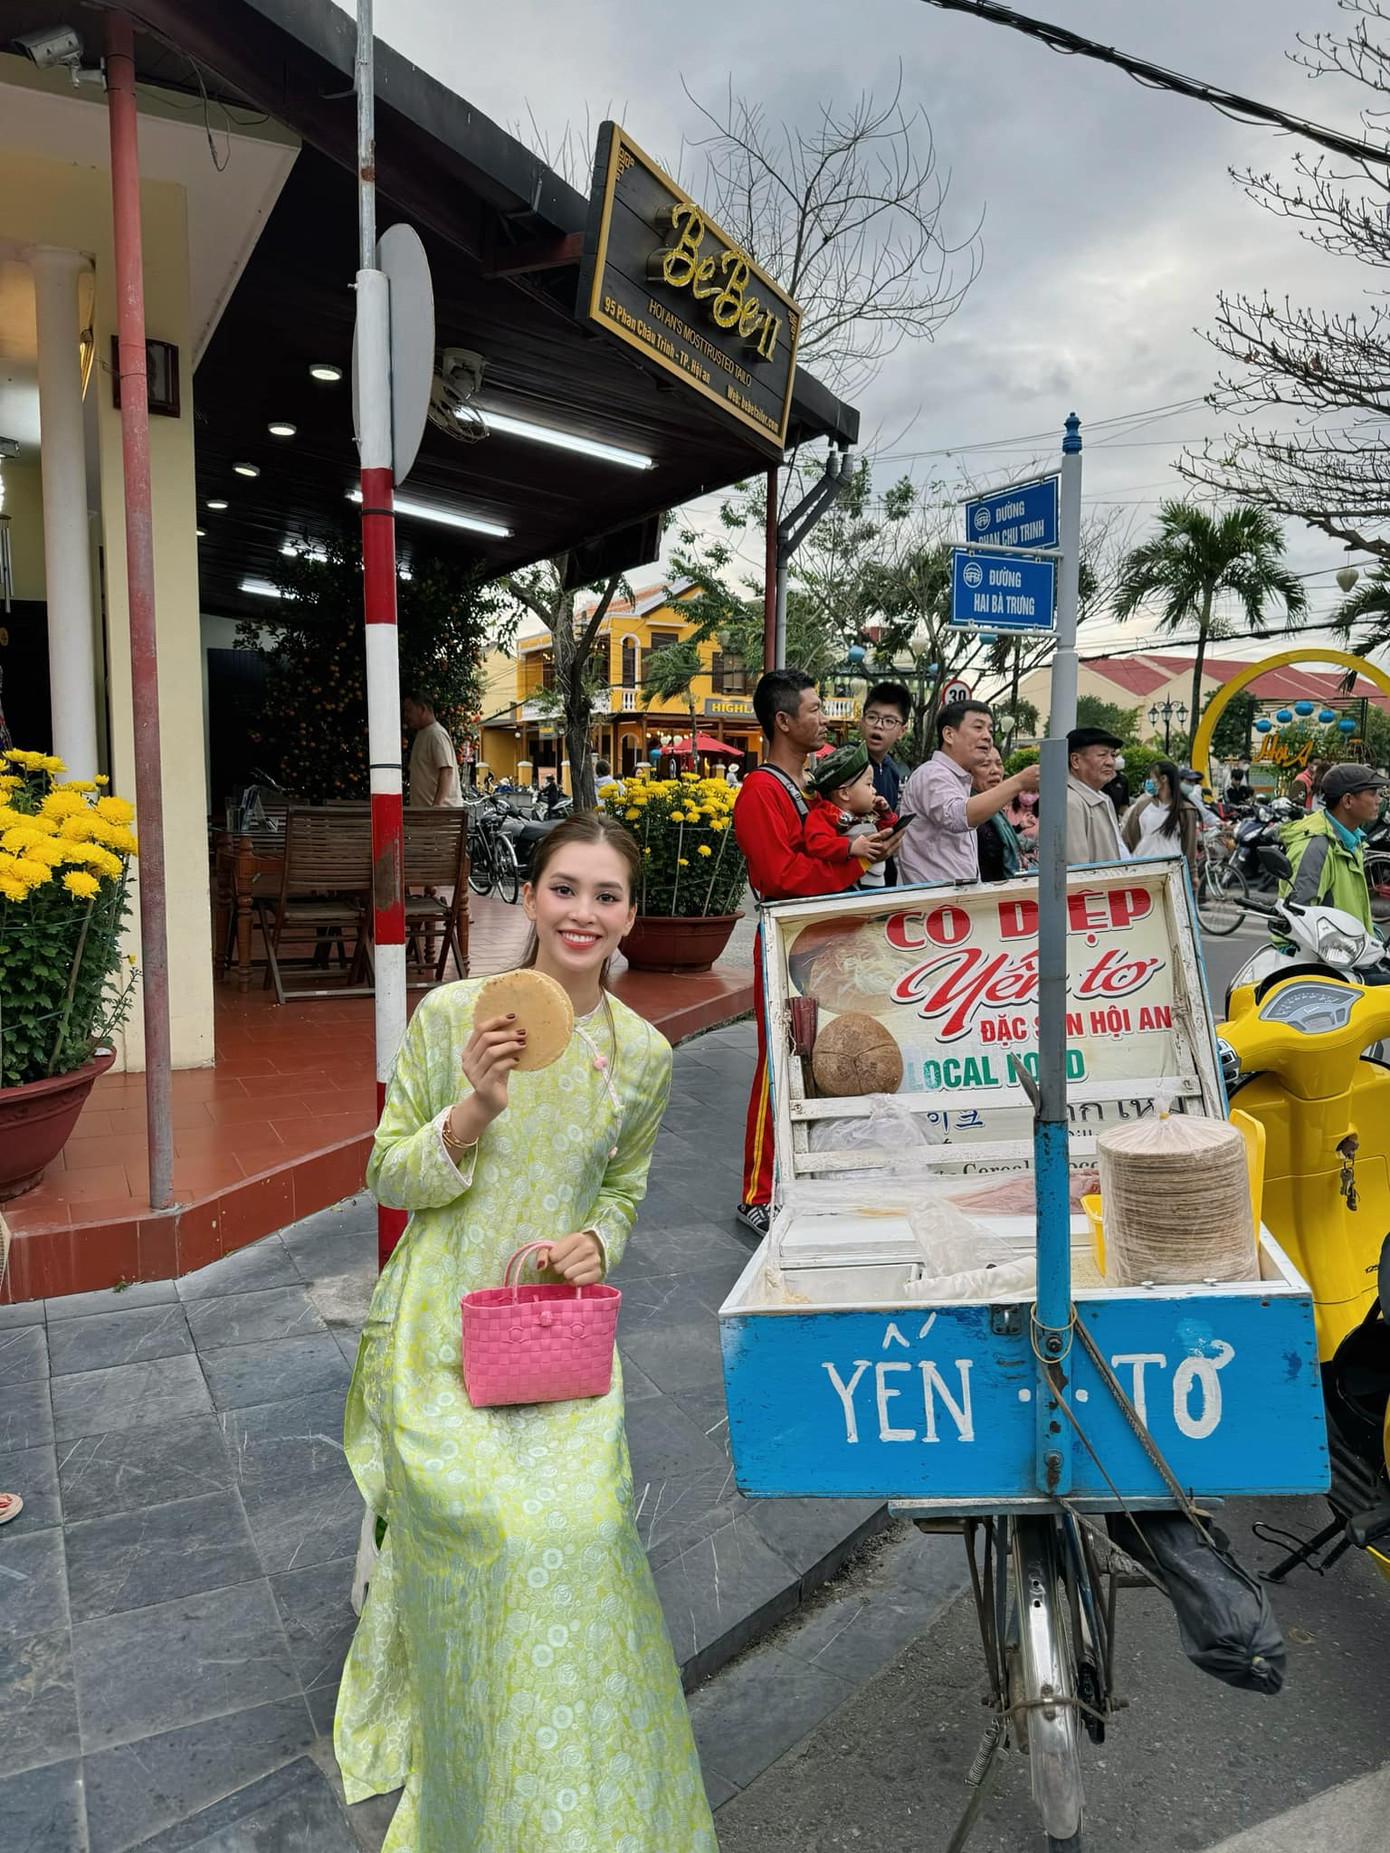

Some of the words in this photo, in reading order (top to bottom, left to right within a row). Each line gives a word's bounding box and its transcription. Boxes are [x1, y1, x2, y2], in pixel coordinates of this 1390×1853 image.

[604, 296, 616, 316] 95
[616, 305, 636, 331] Phan
[637, 319, 656, 344] Châu
[656, 333, 675, 359] Trinh
[995, 500, 1025, 523] ĐƯỜNG
[1001, 526, 1018, 546] CHU
[1019, 519, 1045, 542] TRINH
[989, 566, 1022, 588] ĐƯỜNG
[973, 593, 990, 613] HAI
[991, 591, 1004, 614] BÀ
[1005, 594, 1035, 616] TRƯNG
[711, 702, 754, 714] HIGHL
[949, 689, 967, 704] 30
[885, 904, 971, 948] CÔ
[998, 886, 1152, 944] DỆP
[980, 1014, 1027, 1046] ĐẶC
[1090, 1004, 1131, 1038] HỘI
[1138, 1005, 1173, 1030] AN
[821, 1313, 976, 1444] YẾN
[1110, 1338, 1236, 1440] TƠ
